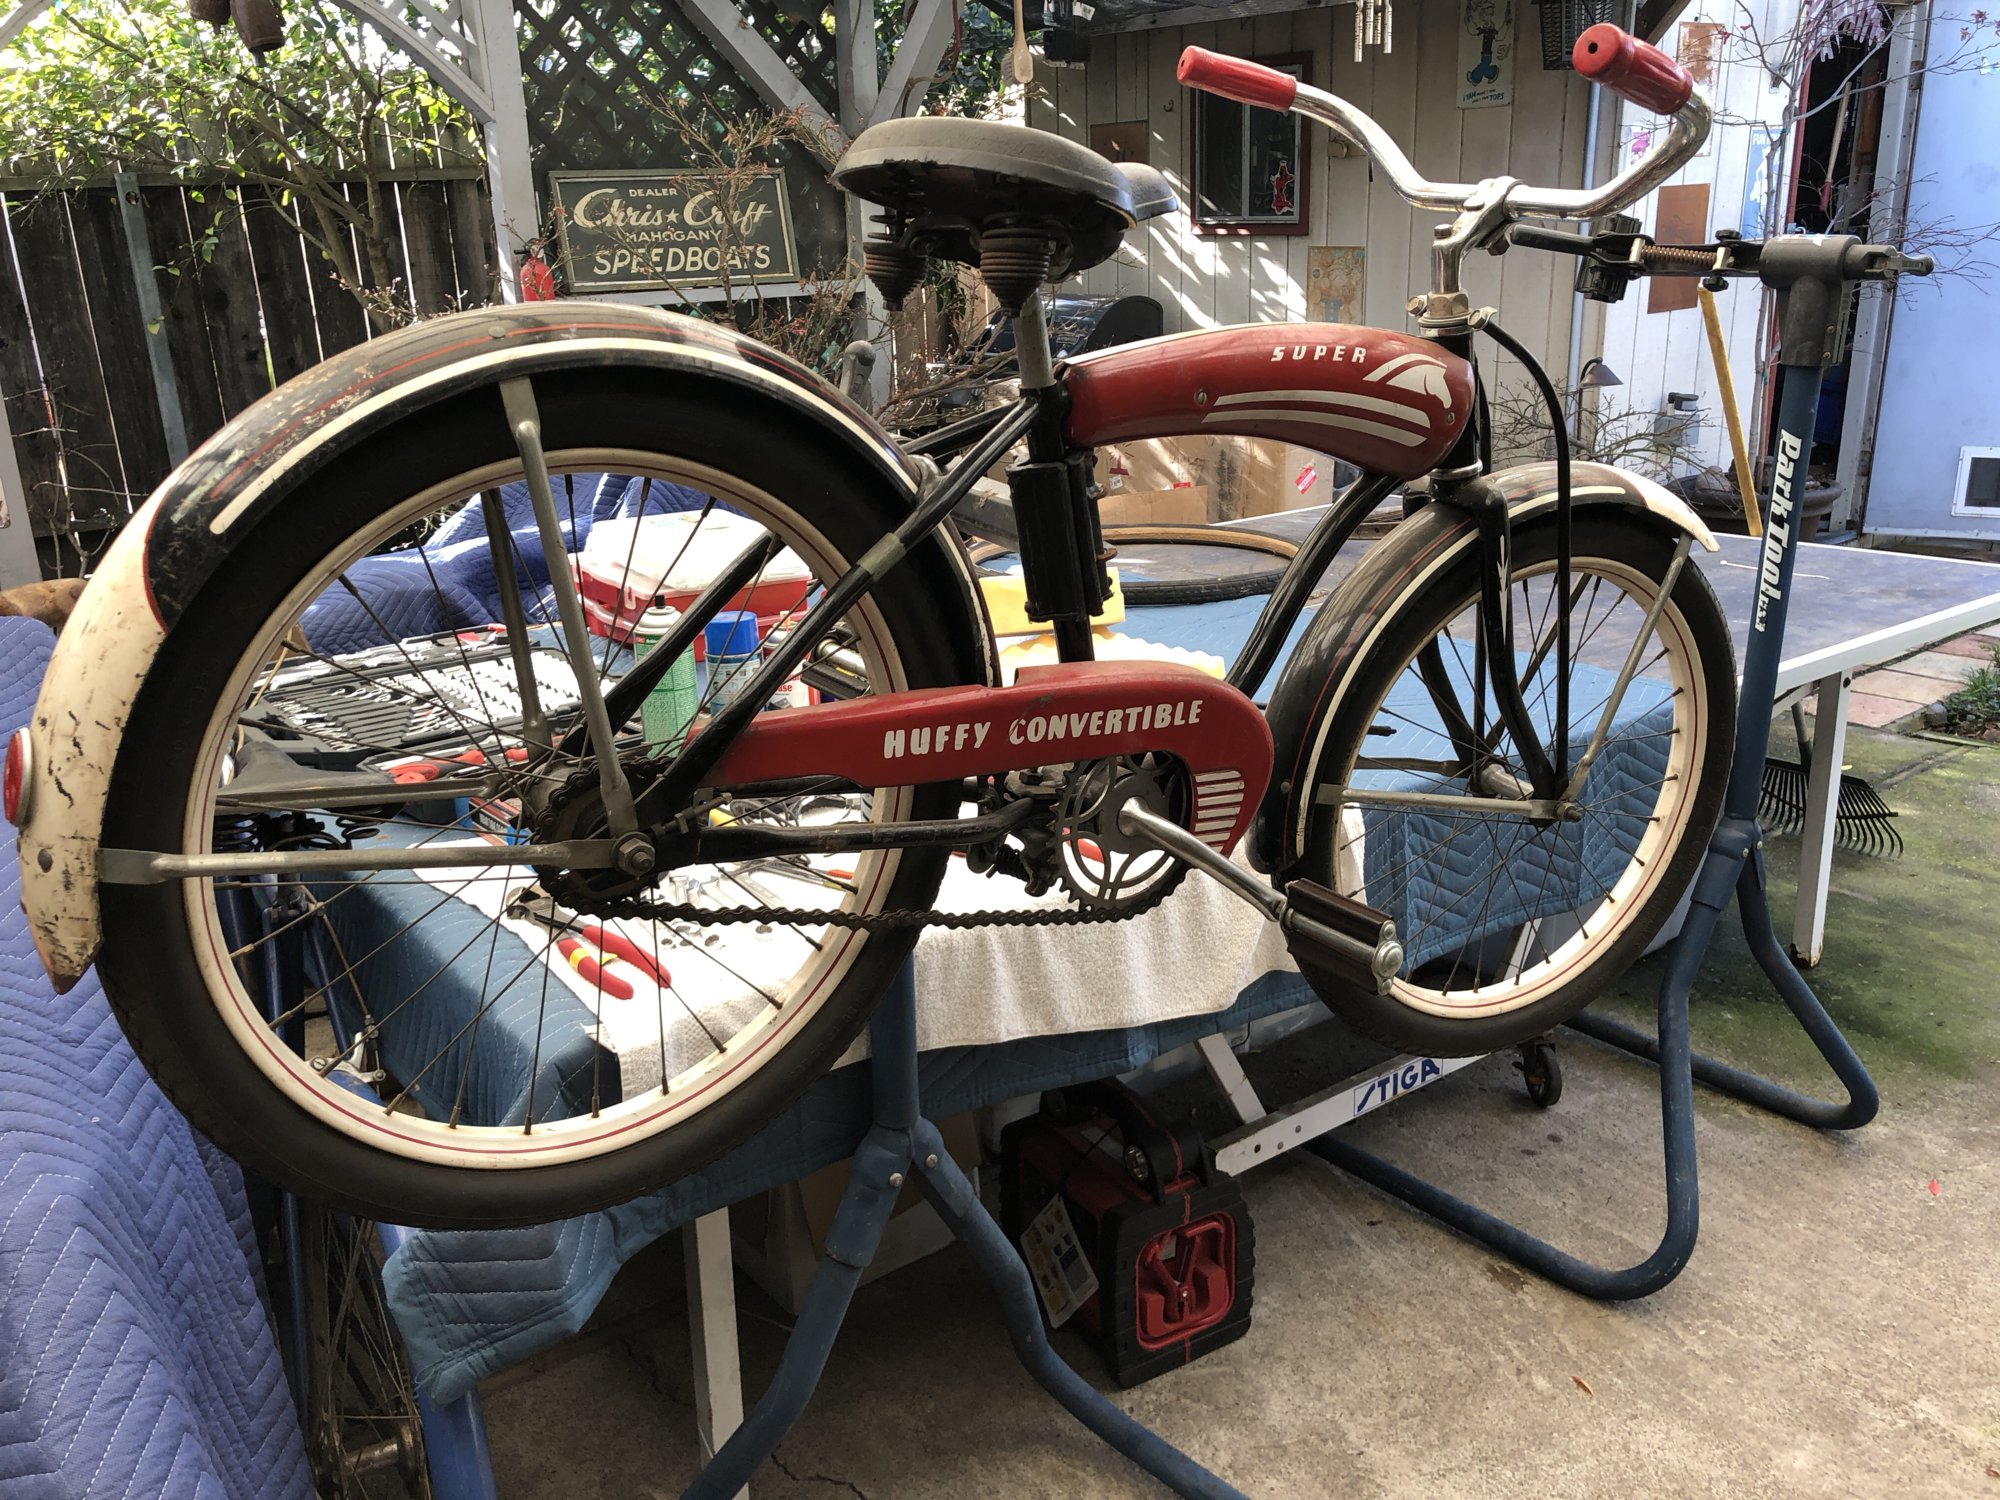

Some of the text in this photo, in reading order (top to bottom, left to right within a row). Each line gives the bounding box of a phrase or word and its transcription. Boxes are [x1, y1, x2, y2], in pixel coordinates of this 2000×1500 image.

[629, 188, 678, 197] DEALER
[574, 188, 664, 228] Chris
[627, 229, 722, 243] MAHOGANY
[593, 245, 771, 275] SPEEDBOATS
[1271, 345, 1367, 363] SUPER
[883, 700, 1204, 759] HUFFY CONVERTIBLE
[1357, 1058, 1440, 1112] STIGA
